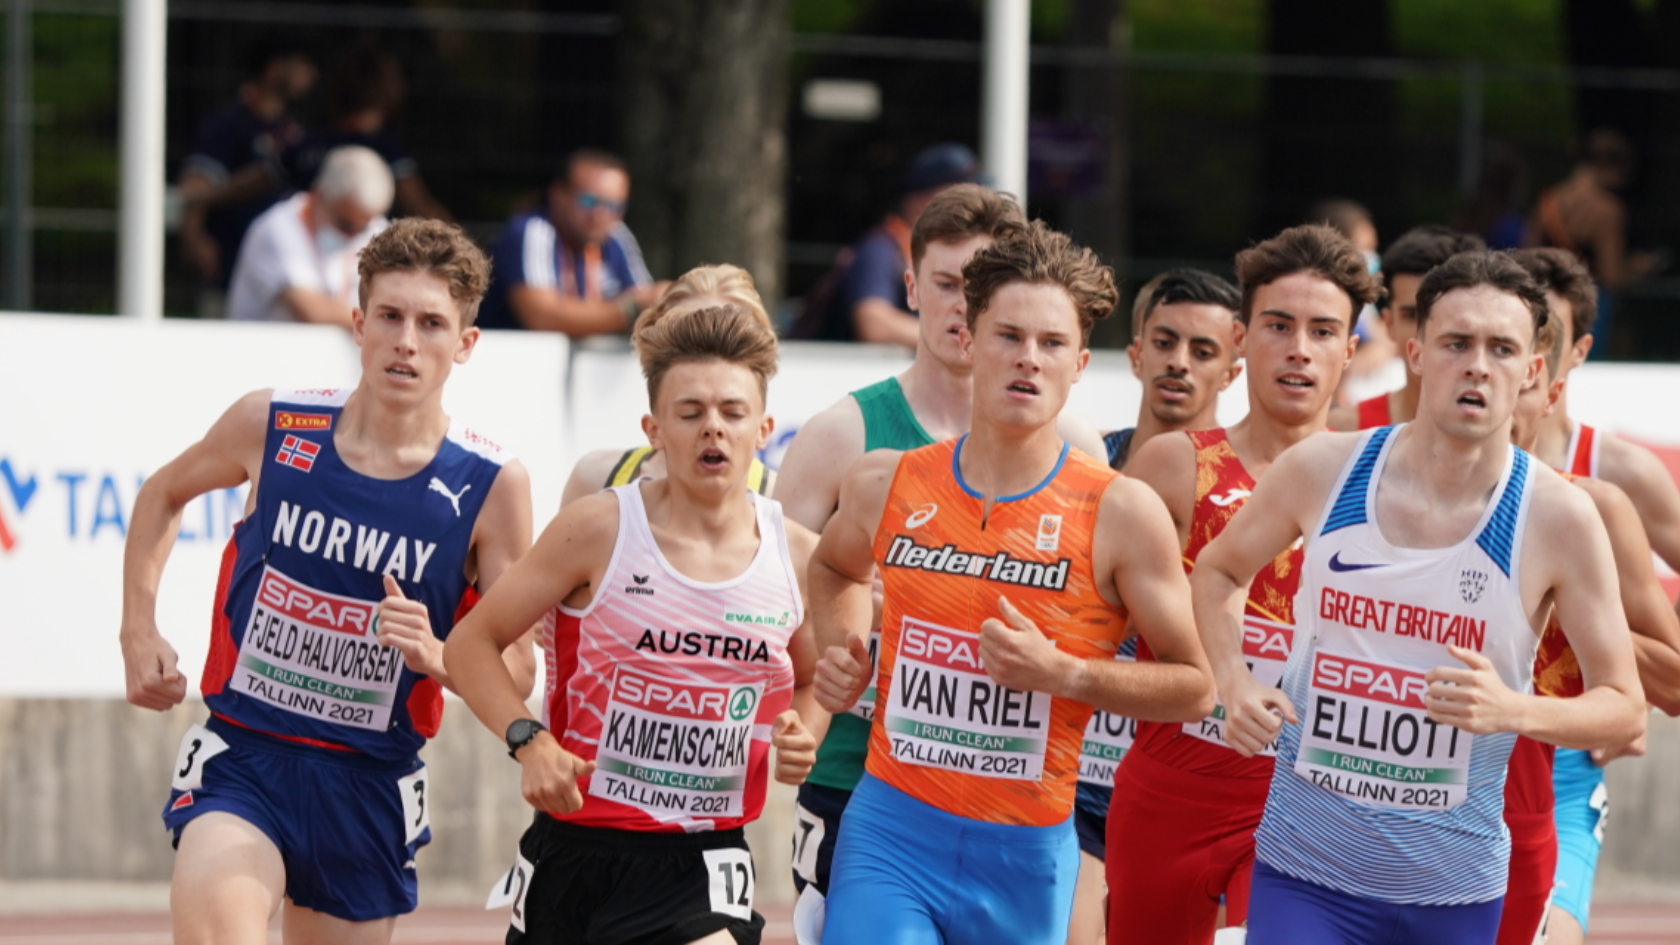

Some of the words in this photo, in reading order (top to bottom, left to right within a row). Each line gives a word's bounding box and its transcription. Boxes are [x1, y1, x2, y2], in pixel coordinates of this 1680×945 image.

[295, 417, 327, 426] EXTRA
[272, 501, 437, 584] NORWAY
[262, 573, 367, 632] SPAR
[625, 586, 654, 595] erima
[725, 612, 753, 623] EVA
[755, 616, 775, 625] AIR
[1320, 587, 1395, 632] GREAT
[1395, 604, 1486, 653] BRITAIN
[247, 608, 298, 661] FJELD
[297, 629, 402, 685] HALVORSEN
[635, 629, 769, 663] AUSTRIA
[266, 667, 271, 676] I
[273, 668, 304, 687] RUN
[246, 675, 325, 715] TALLINN
[328, 703, 374, 725] 2021
[617, 679, 725, 717] SPAR
[901, 664, 958, 718] VAN
[968, 681, 1041, 729] RIEL
[605, 709, 749, 769] KAMENSCHAK
[914, 724, 920, 735] I
[922, 725, 953, 742] RUN
[179, 738, 202, 778] 3
[626, 764, 632, 776] I
[634, 766, 665, 782] RUN
[892, 739, 976, 770] TALLINN
[980, 755, 1027, 775] 2021
[1332, 754, 1337, 765] I
[1340, 756, 1373, 773] RUN
[412, 780, 425, 828] 3
[605, 777, 687, 811] TALLINN
[690, 796, 730, 812] 2021
[1309, 769, 1397, 803] TALLINN
[1401, 788, 1449, 806] 2021
[718, 861, 750, 906] 12
